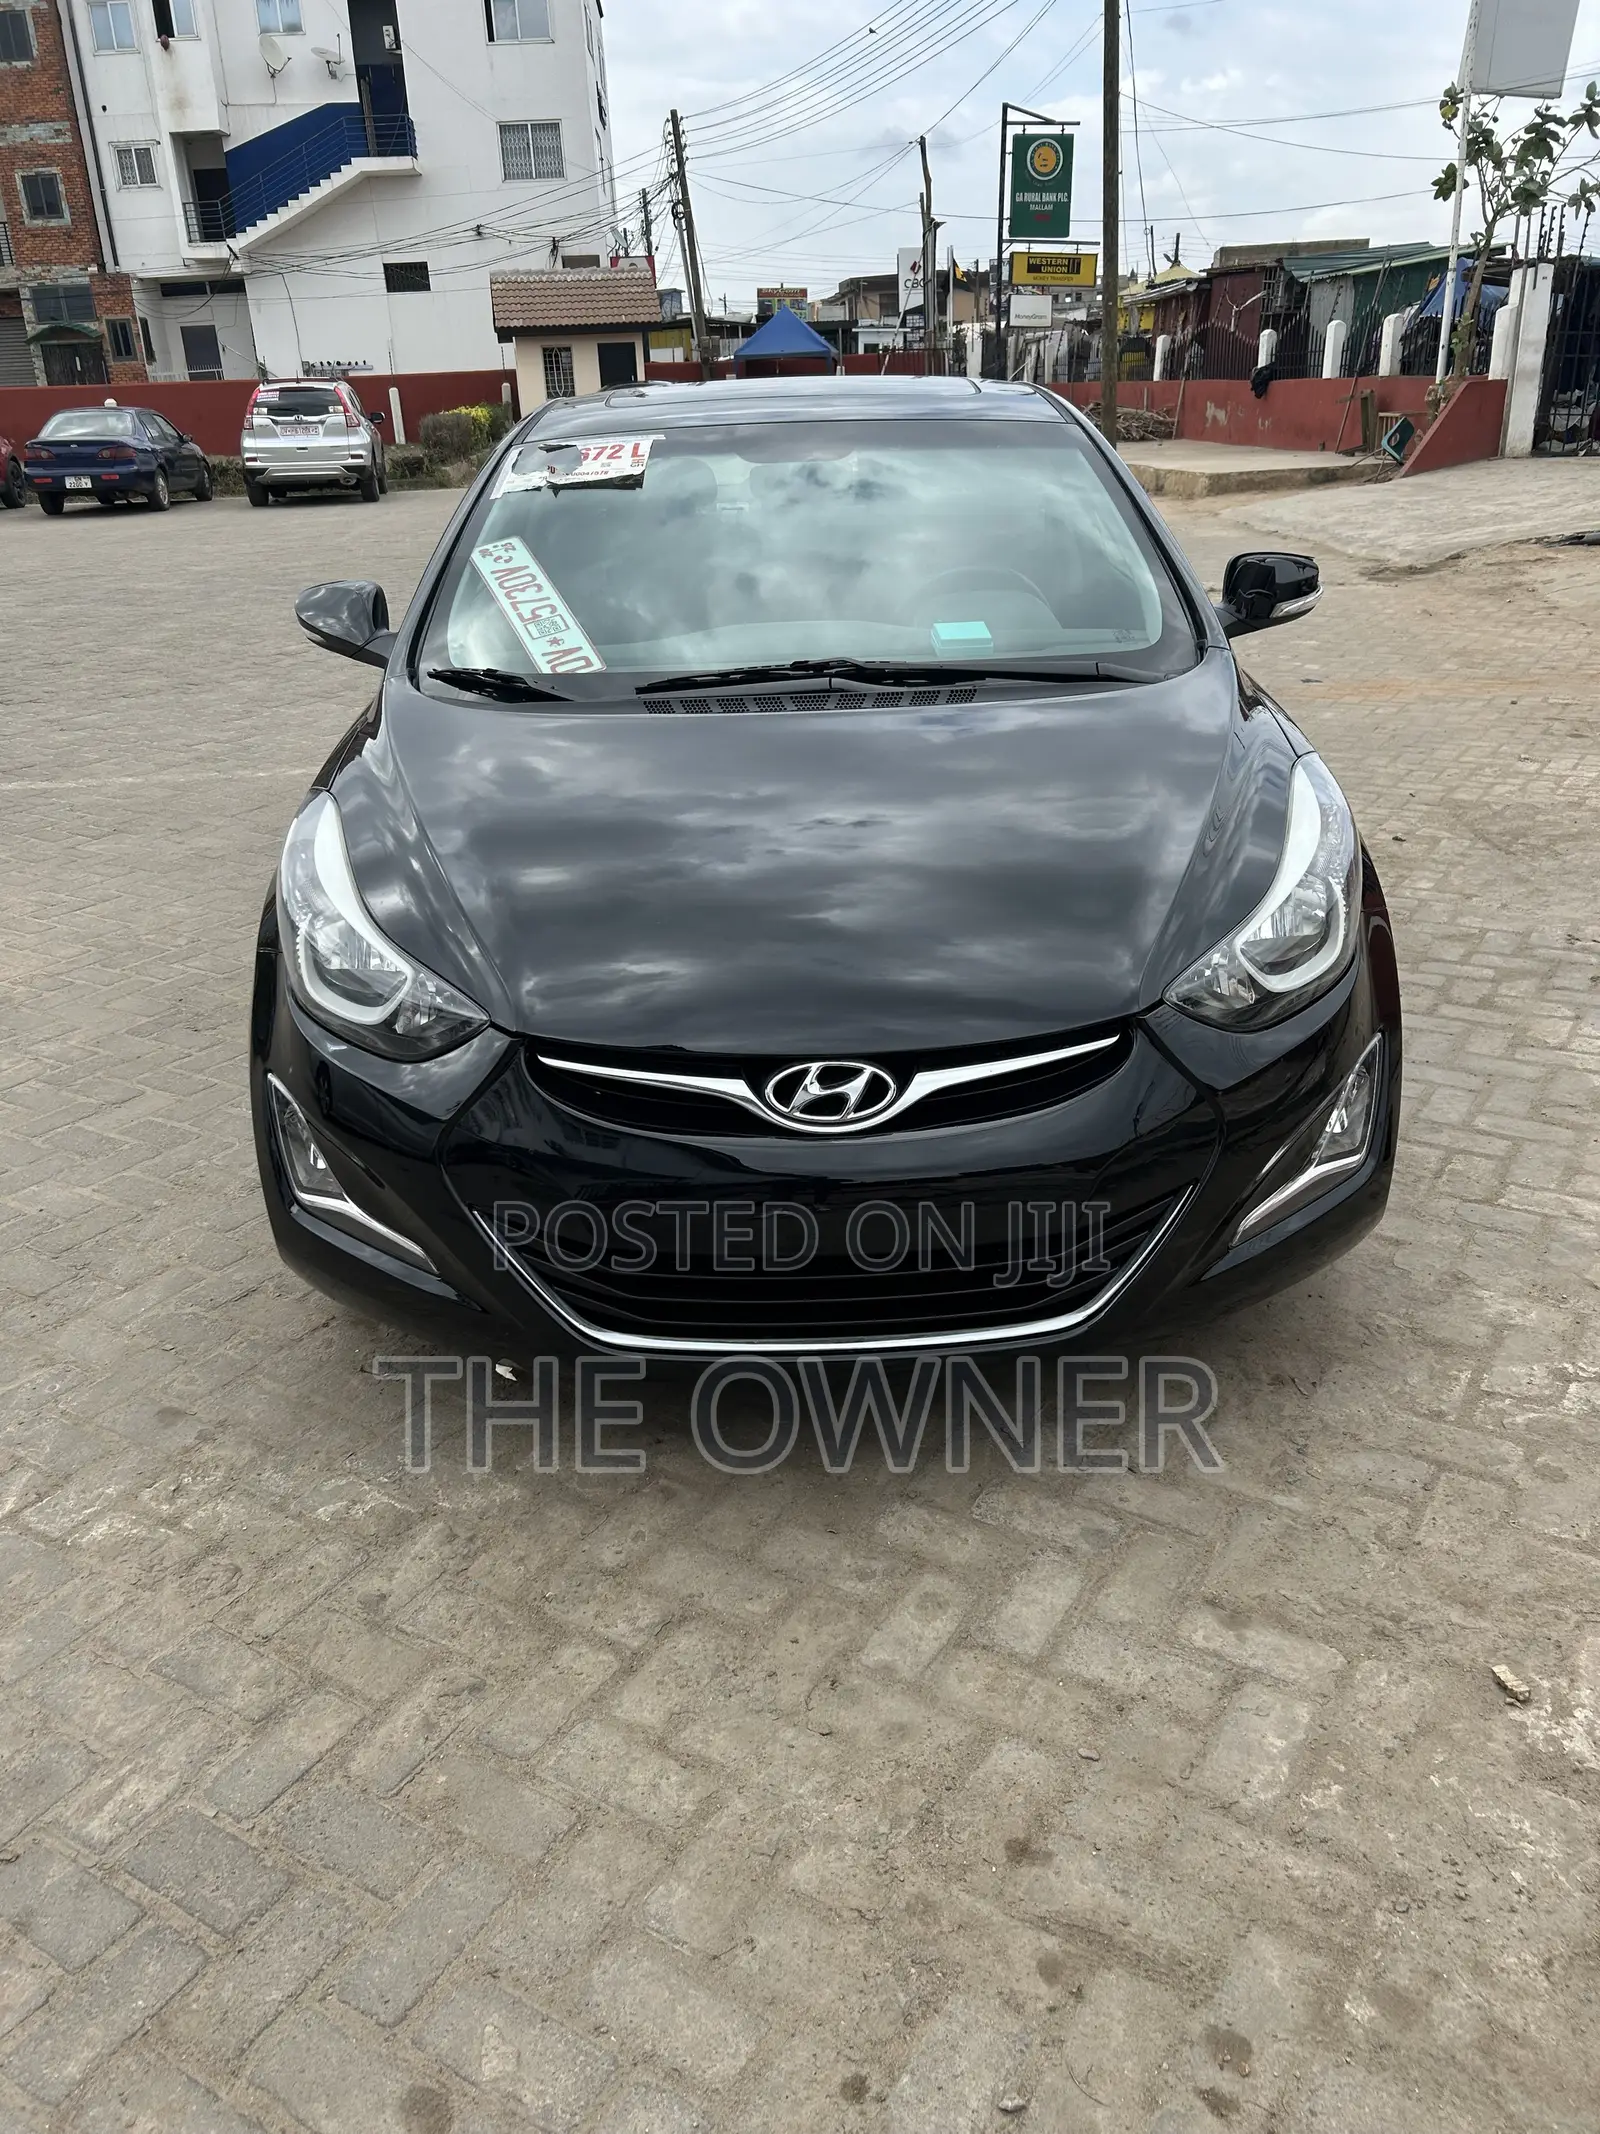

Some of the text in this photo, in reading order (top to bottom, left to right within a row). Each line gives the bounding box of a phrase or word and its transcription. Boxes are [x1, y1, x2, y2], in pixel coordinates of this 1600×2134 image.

[1015, 192, 1023, 202] GA
[1024, 192, 1041, 202] RURAL
[1042, 192, 1057, 202] BANK
[1029, 203, 1054, 211] MALLAM
[1028, 257, 1069, 265] WESTERN
[631, 442, 646, 458] L
[490, 565, 558, 623] 5730V
[541, 646, 595, 675] DV
